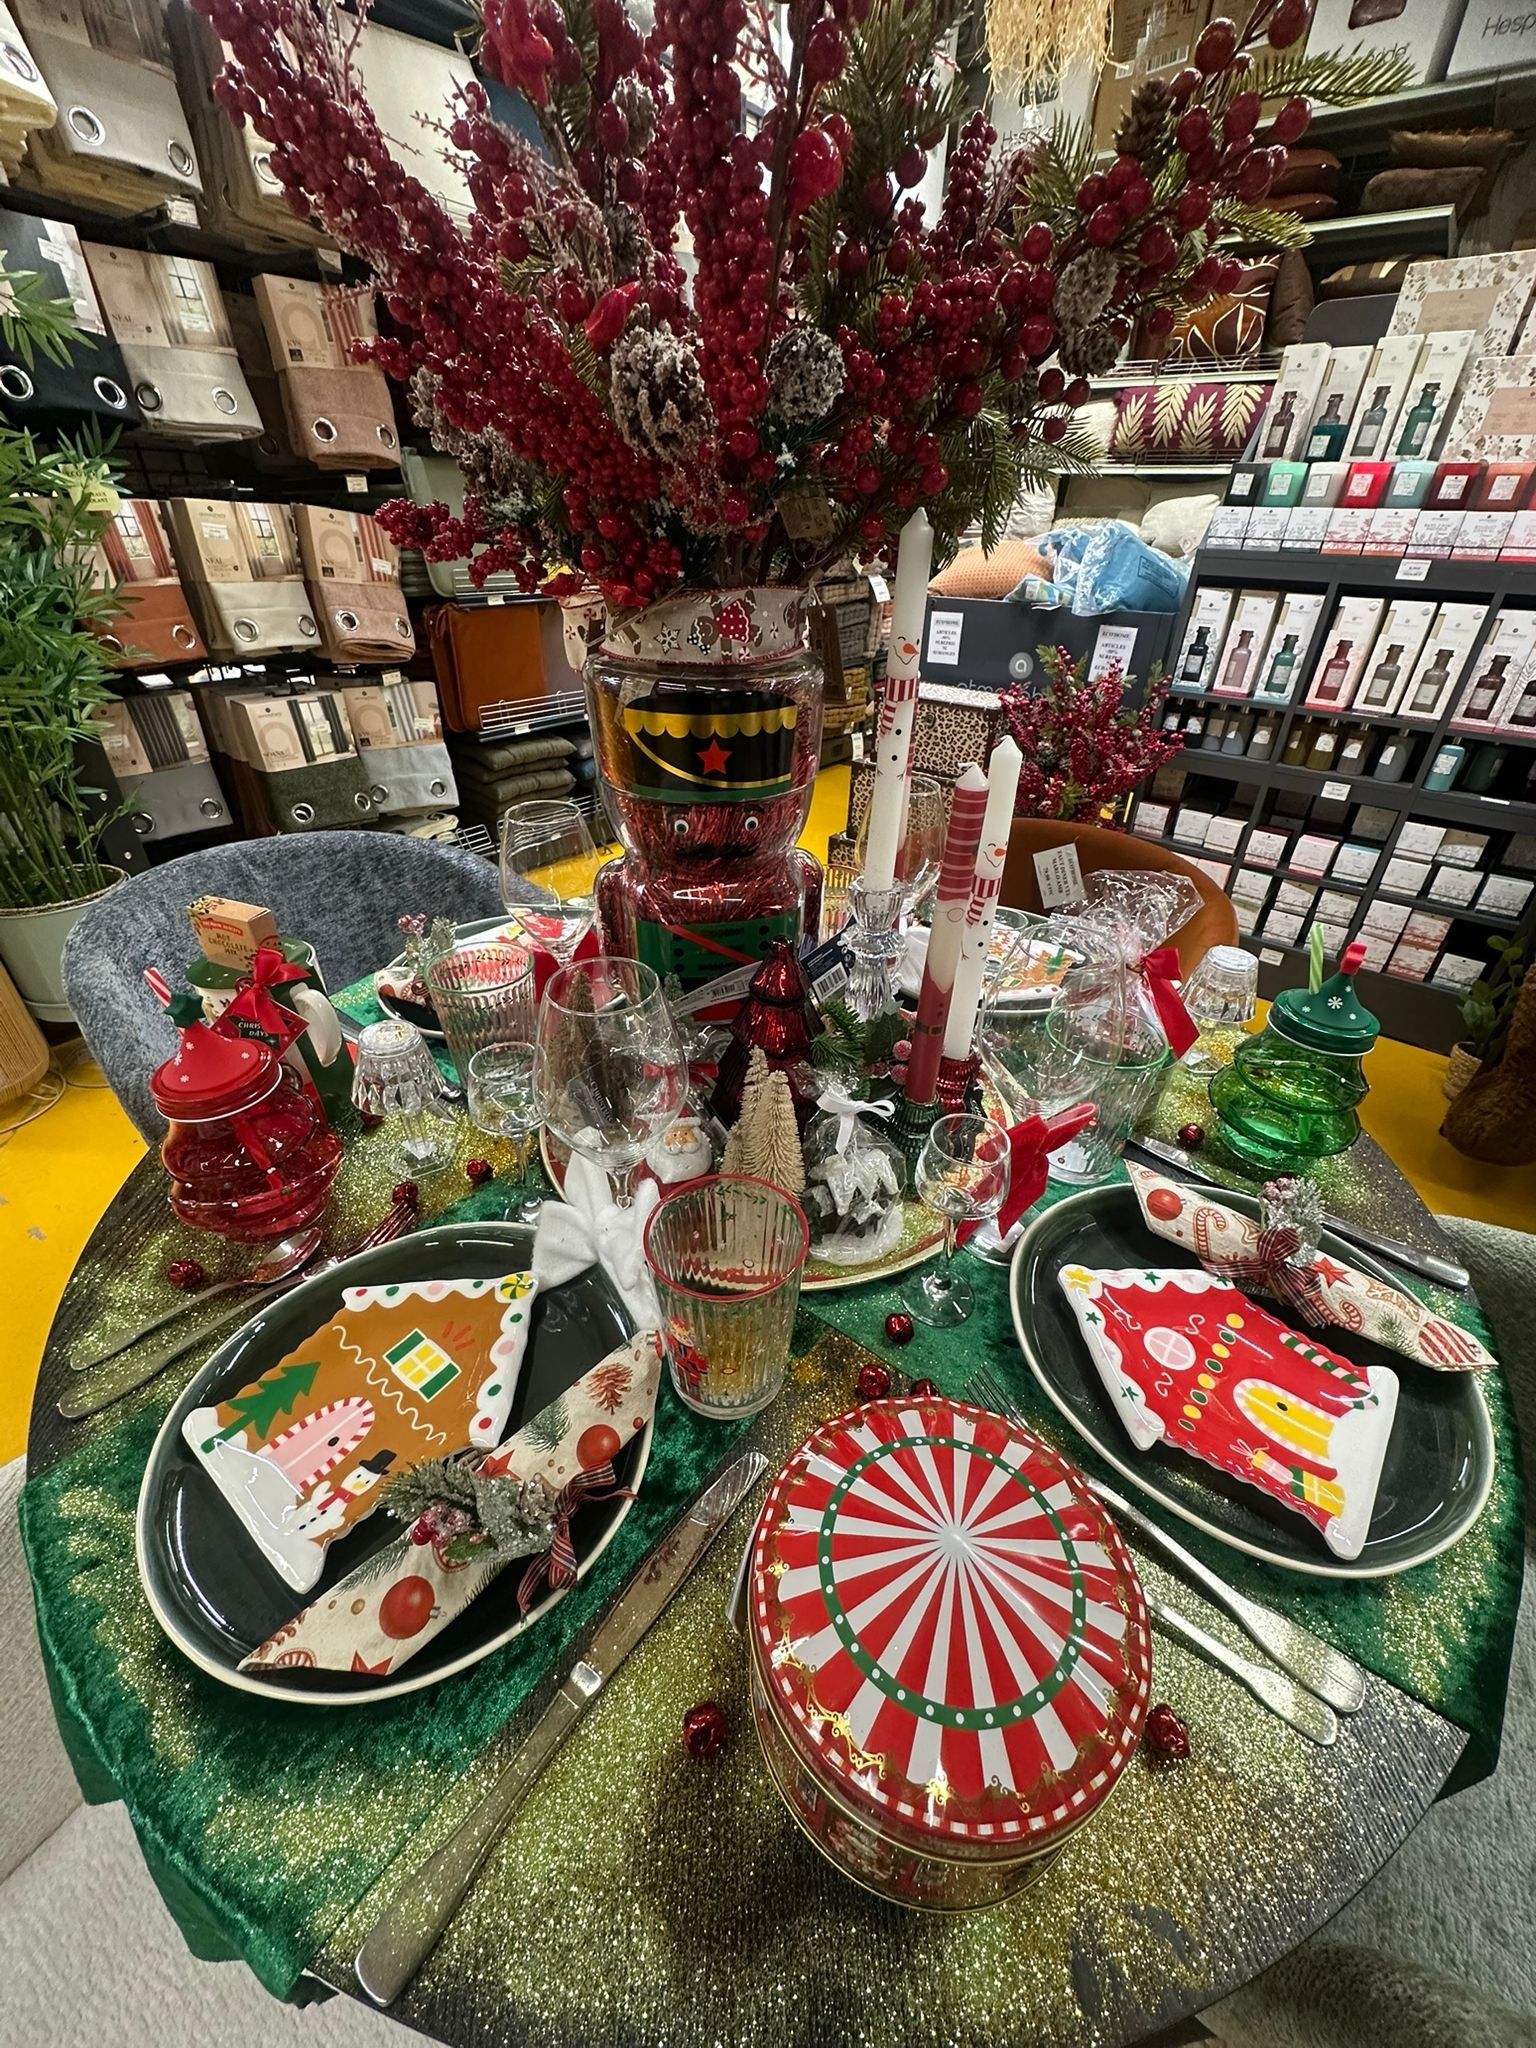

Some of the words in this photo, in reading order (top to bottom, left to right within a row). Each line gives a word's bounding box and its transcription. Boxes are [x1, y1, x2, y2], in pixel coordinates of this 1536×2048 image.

[216, 933, 231, 941] HOT
[208, 937, 248, 953] CHOCOLATE
[248, 1030, 269, 1038] DAYS
